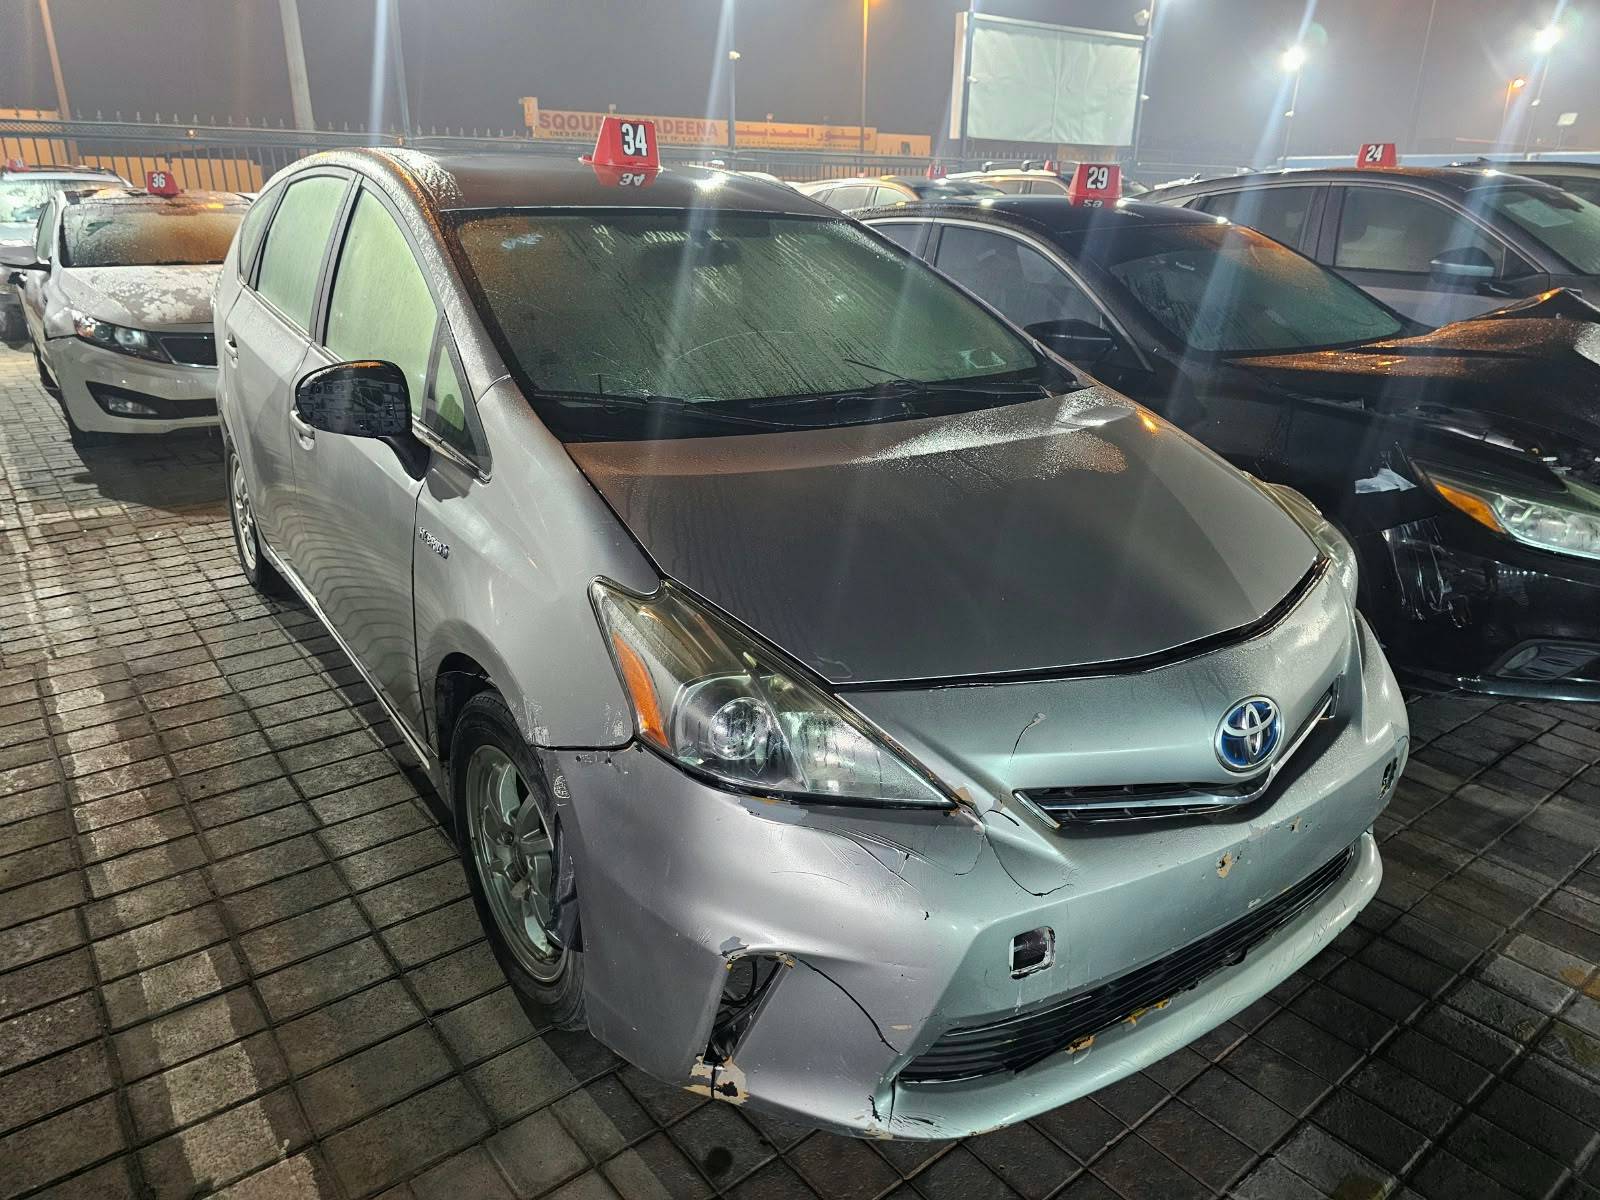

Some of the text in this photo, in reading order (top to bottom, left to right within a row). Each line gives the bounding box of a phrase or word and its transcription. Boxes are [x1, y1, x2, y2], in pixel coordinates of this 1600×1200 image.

[621, 123, 648, 156] 34
[1365, 144, 1384, 162] 24
[152, 173, 166, 188] 36
[1087, 166, 1109, 190] 29
